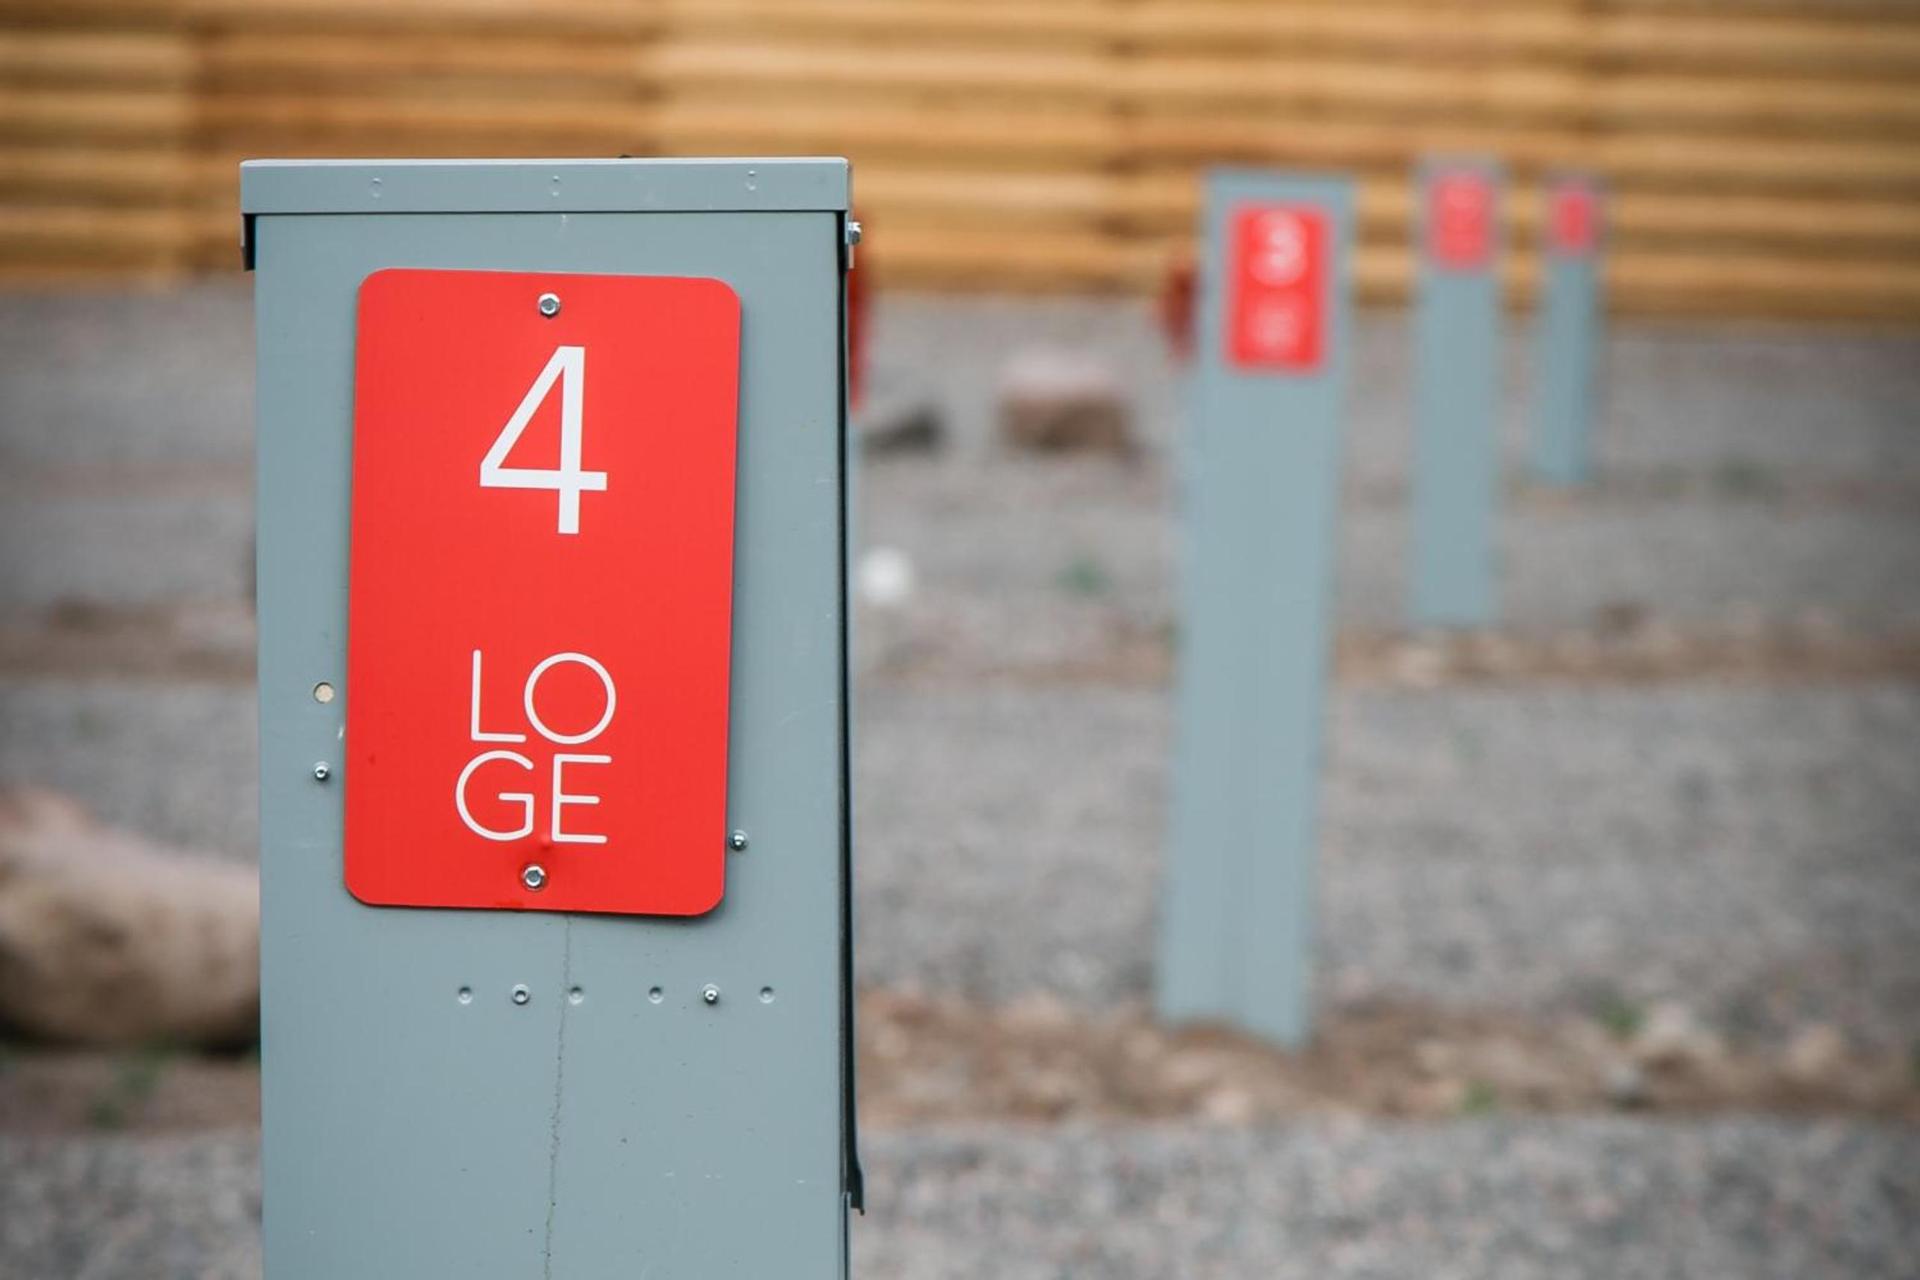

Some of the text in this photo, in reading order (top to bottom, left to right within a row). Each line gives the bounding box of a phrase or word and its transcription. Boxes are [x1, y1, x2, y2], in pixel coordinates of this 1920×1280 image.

[1252, 211, 1307, 283] 3
[479, 345, 608, 535] 4
[470, 649, 616, 745] LO
[455, 750, 612, 844] GE
